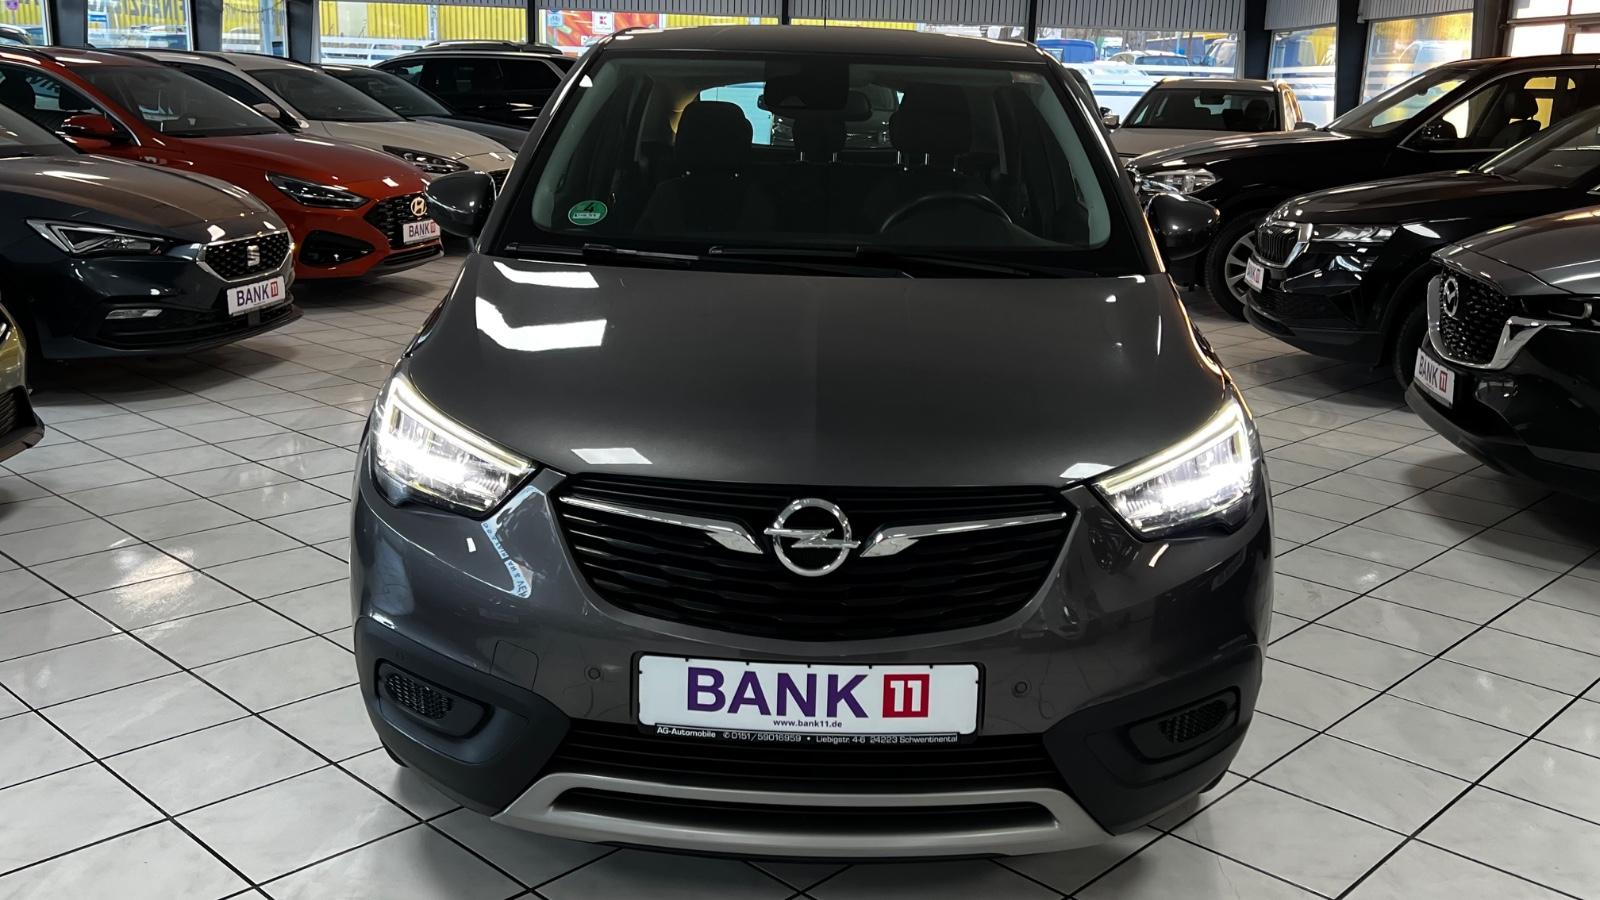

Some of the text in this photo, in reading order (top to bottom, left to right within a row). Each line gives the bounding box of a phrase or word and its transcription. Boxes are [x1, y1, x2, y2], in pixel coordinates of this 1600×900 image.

[408, 222, 430, 238] BANK
[236, 282, 278, 307] BANK 11
[1419, 355, 1439, 388] BANK
[688, 667, 924, 719] BANK 11
[773, 719, 843, 729] www.bank11.de
[656, 726, 717, 738] AG-Automobile
[899, 732, 958, 744] Schwentinental
